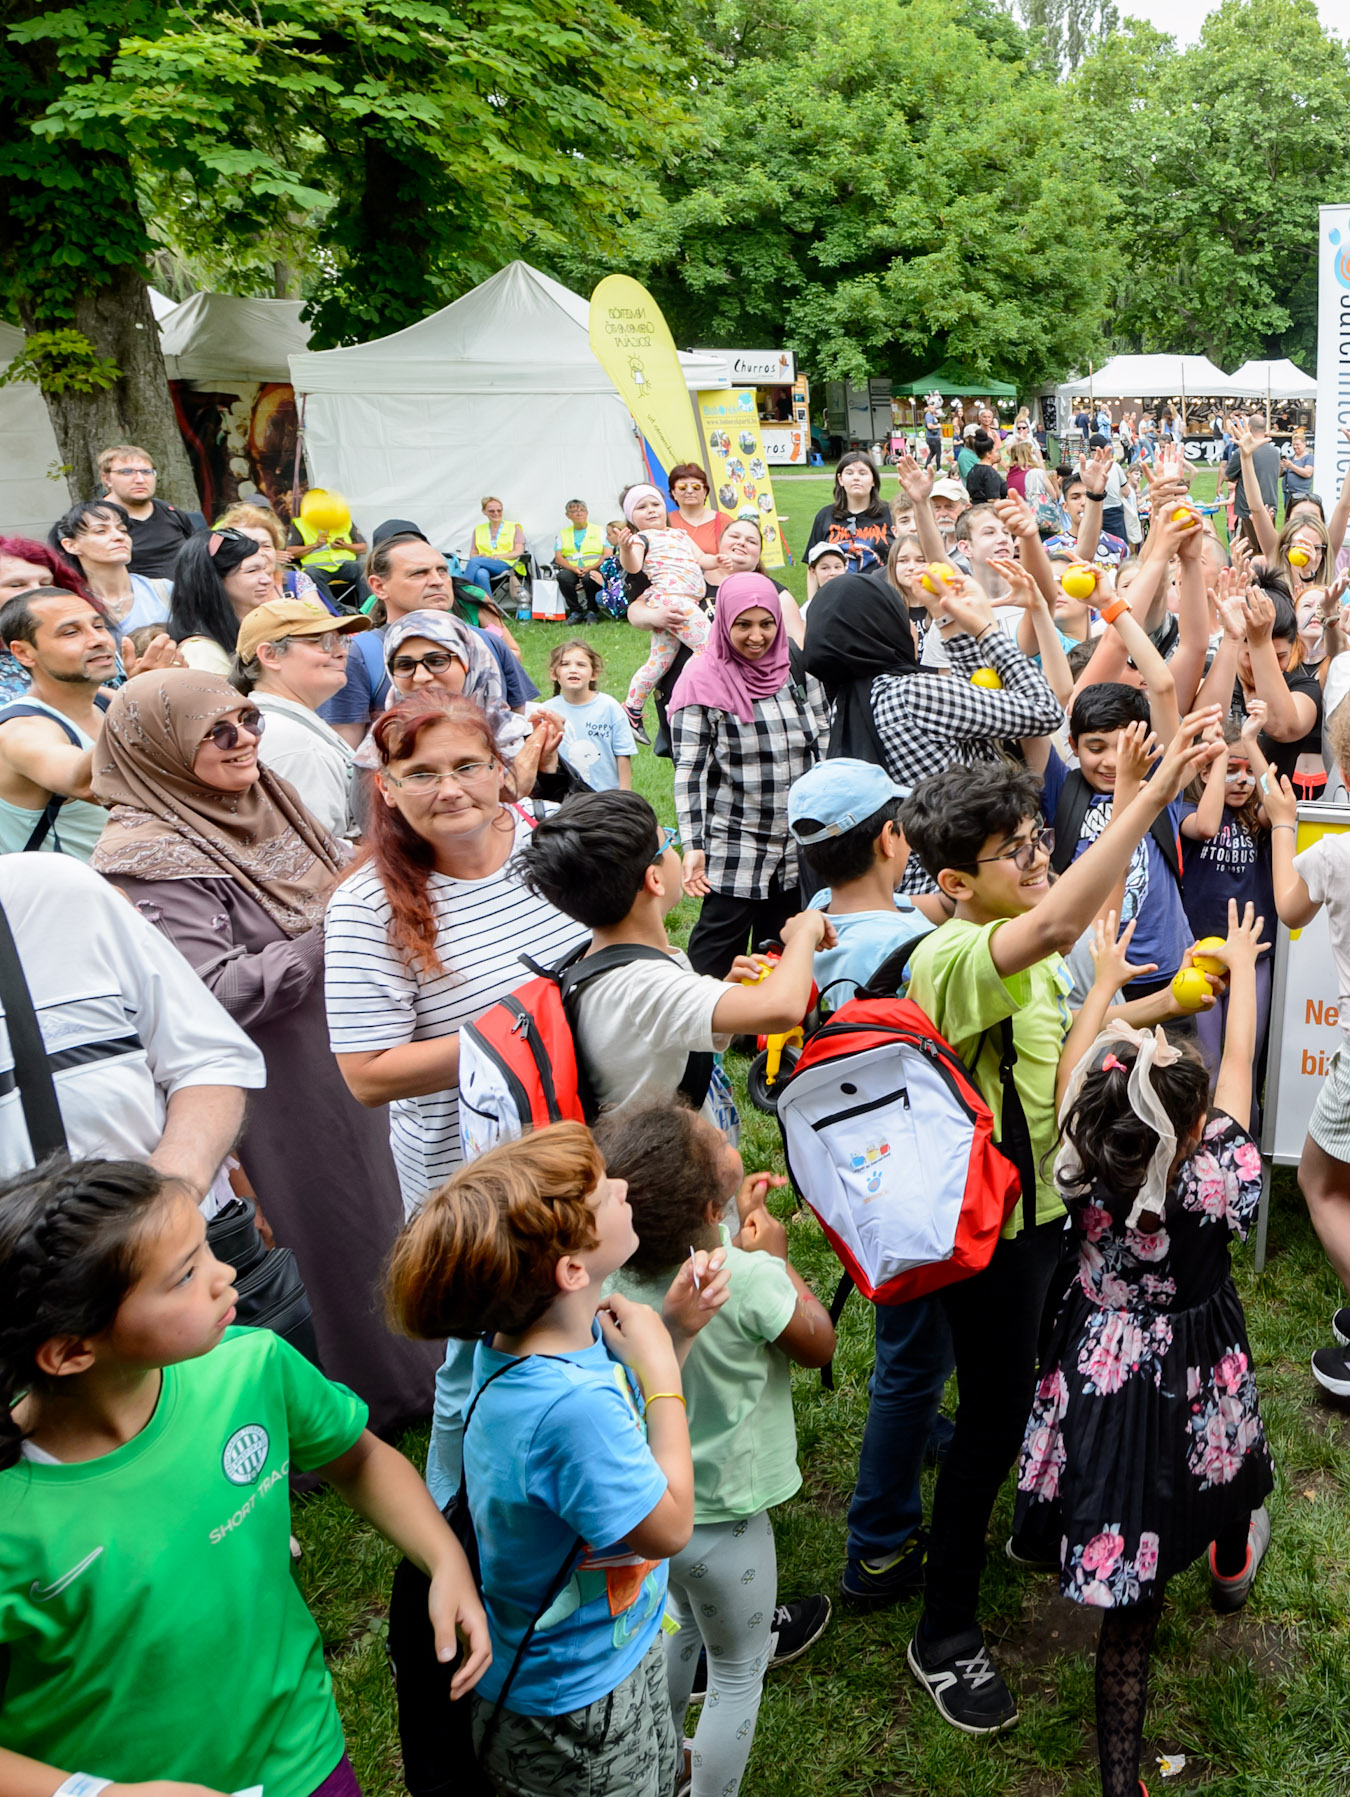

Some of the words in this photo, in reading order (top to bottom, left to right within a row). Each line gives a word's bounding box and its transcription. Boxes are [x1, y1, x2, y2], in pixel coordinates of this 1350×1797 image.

[734, 358, 776, 374] Churros
[1200, 846, 1258, 864] #TOOBUS
[1305, 998, 1339, 1027] Ne
[208, 1493, 257, 1545] SHORT
